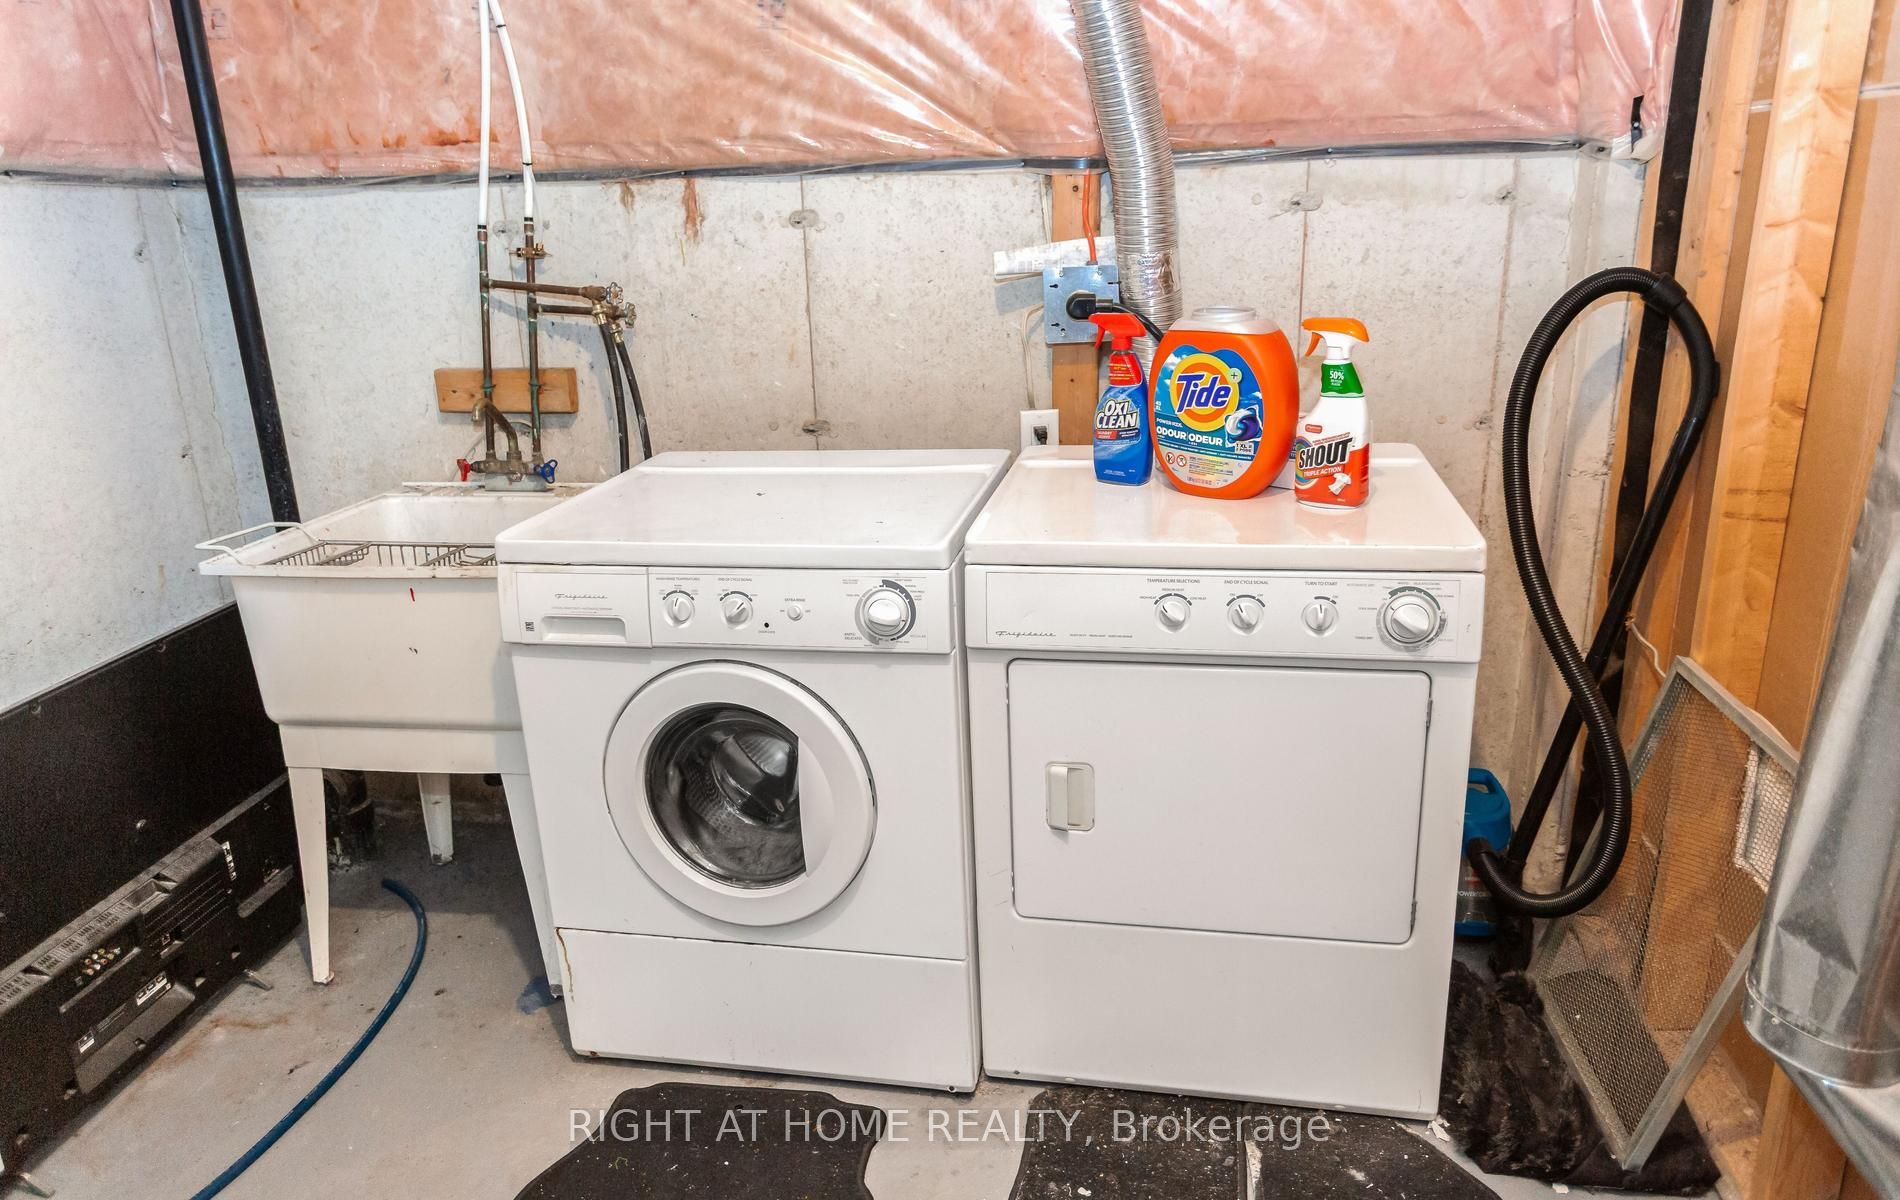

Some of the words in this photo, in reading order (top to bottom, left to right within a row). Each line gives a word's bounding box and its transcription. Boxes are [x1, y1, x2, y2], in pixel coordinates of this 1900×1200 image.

[1329, 370, 1344, 380] 50%
[1175, 372, 1232, 414] Tide
[1104, 399, 1129, 416] OXI
[1096, 412, 1137, 429] CLEAN
[1156, 426, 1187, 440] ODOUR
[1188, 432, 1223, 447] ODEUR
[1299, 437, 1353, 469] SHOUT
[1320, 466, 1343, 475] ACTION
[995, 630, 1057, 638] Frigidaire
